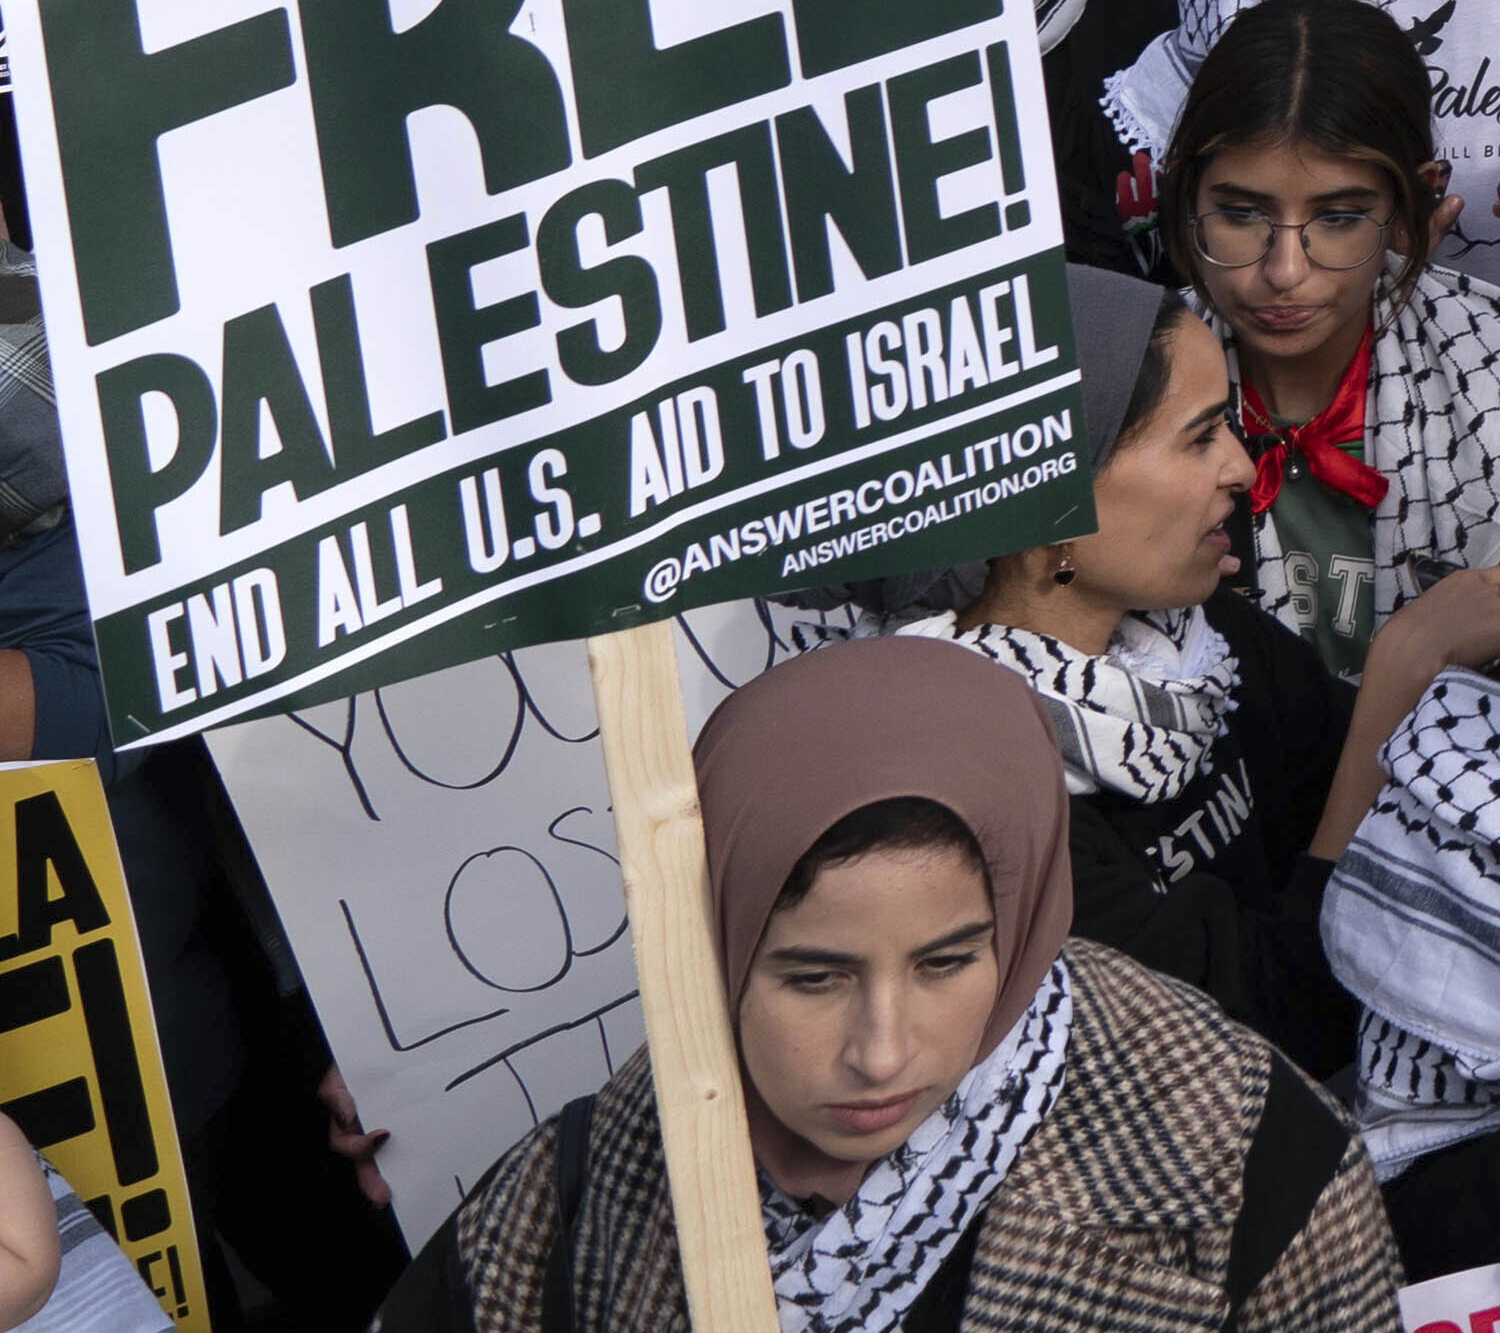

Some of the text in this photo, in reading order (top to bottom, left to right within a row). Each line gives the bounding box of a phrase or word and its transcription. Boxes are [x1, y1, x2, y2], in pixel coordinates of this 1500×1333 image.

[94, 41, 1031, 577] PALESTINE!
[145, 272, 1059, 714] END ALL U.S. AID TO ISRAEL
[643, 409, 1072, 606] @ANSWERCOALITION
[780, 452, 1077, 578] ANSWERCOALITION.ORG
